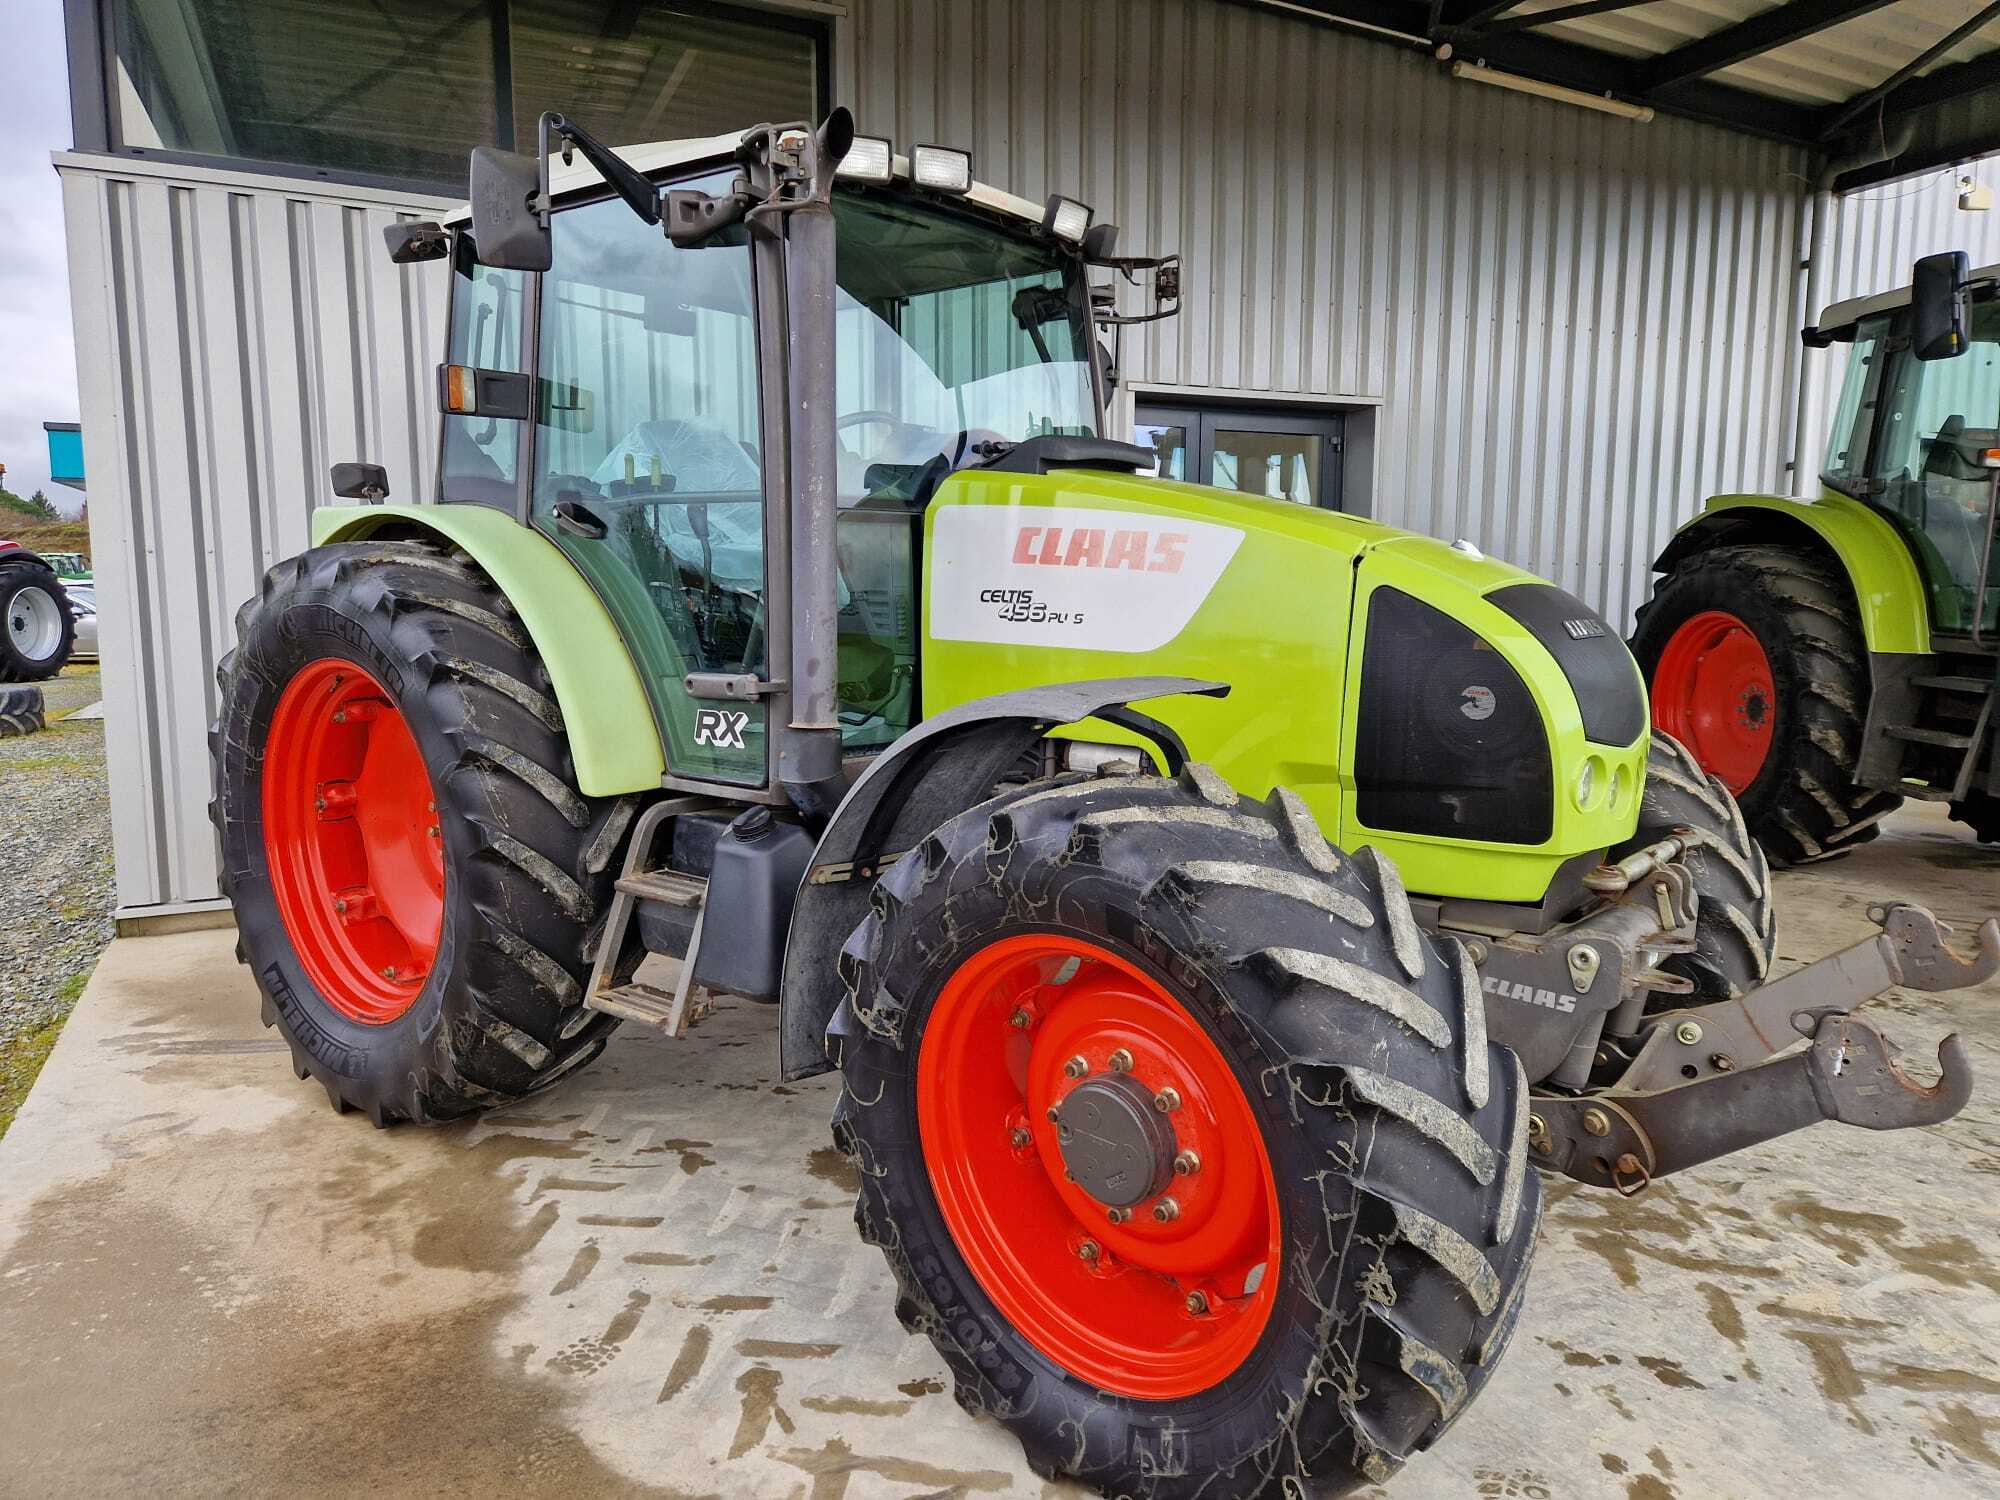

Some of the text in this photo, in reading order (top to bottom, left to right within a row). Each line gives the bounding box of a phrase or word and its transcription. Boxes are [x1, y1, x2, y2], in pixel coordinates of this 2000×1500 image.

[1012, 527, 1189, 573] CLAAS
[980, 590, 1033, 604] CELTIS
[998, 602, 1084, 624] 456 PLS
[693, 709, 749, 749] RX
[1482, 976, 1577, 1013] CLAAS
[263, 966, 350, 1076] MICHELIN
